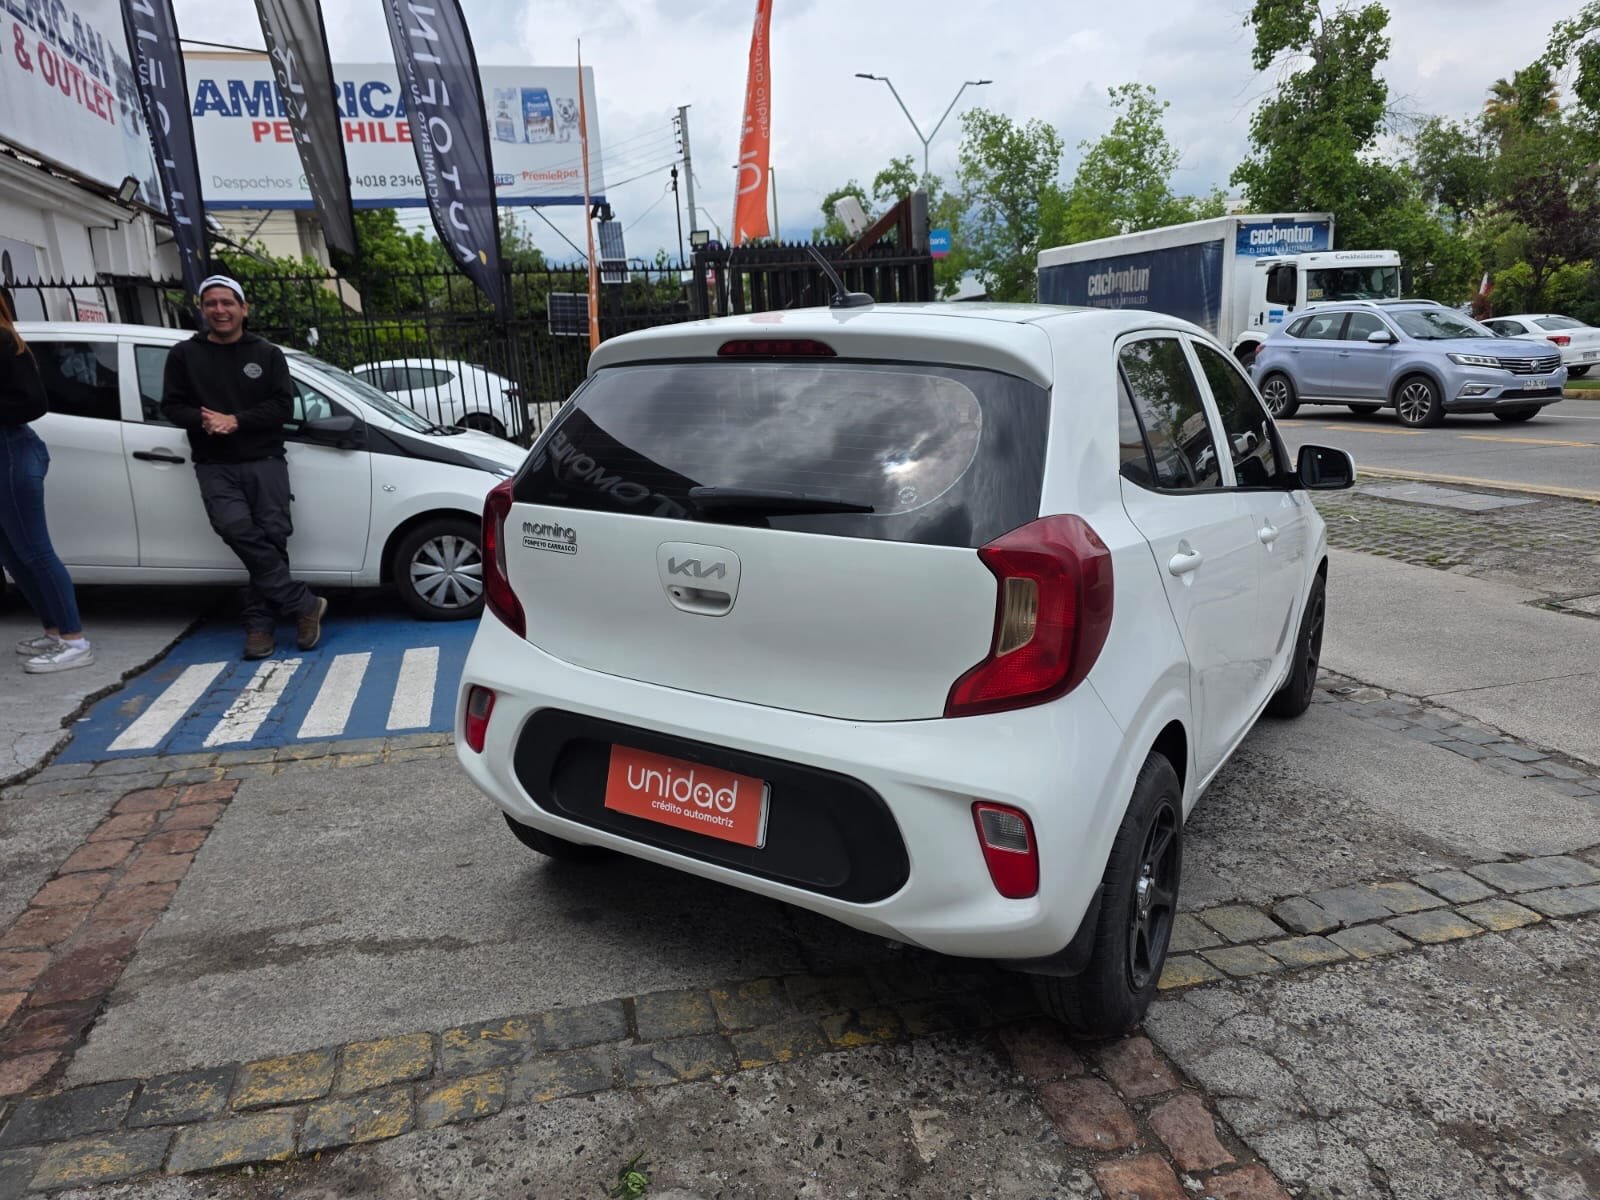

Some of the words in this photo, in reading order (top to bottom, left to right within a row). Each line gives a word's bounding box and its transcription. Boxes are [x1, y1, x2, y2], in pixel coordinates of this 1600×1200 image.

[13, 22, 34, 75] &
[37, 41, 115, 125] OUTLET
[252, 120, 296, 143] PE
[343, 121, 413, 143] HILE
[212, 174, 293, 191] Despachos
[355, 175, 387, 187] 4018
[390, 175, 422, 187] 2346
[522, 521, 577, 543] morning
[524, 538, 547, 548] POMPEYO
[547, 542, 576, 552] CARRASCO
[667, 556, 727, 580] KIA
[627, 764, 738, 813] unidad
[651, 799, 682, 815] crédito
[683, 808, 734, 829] automotriz
